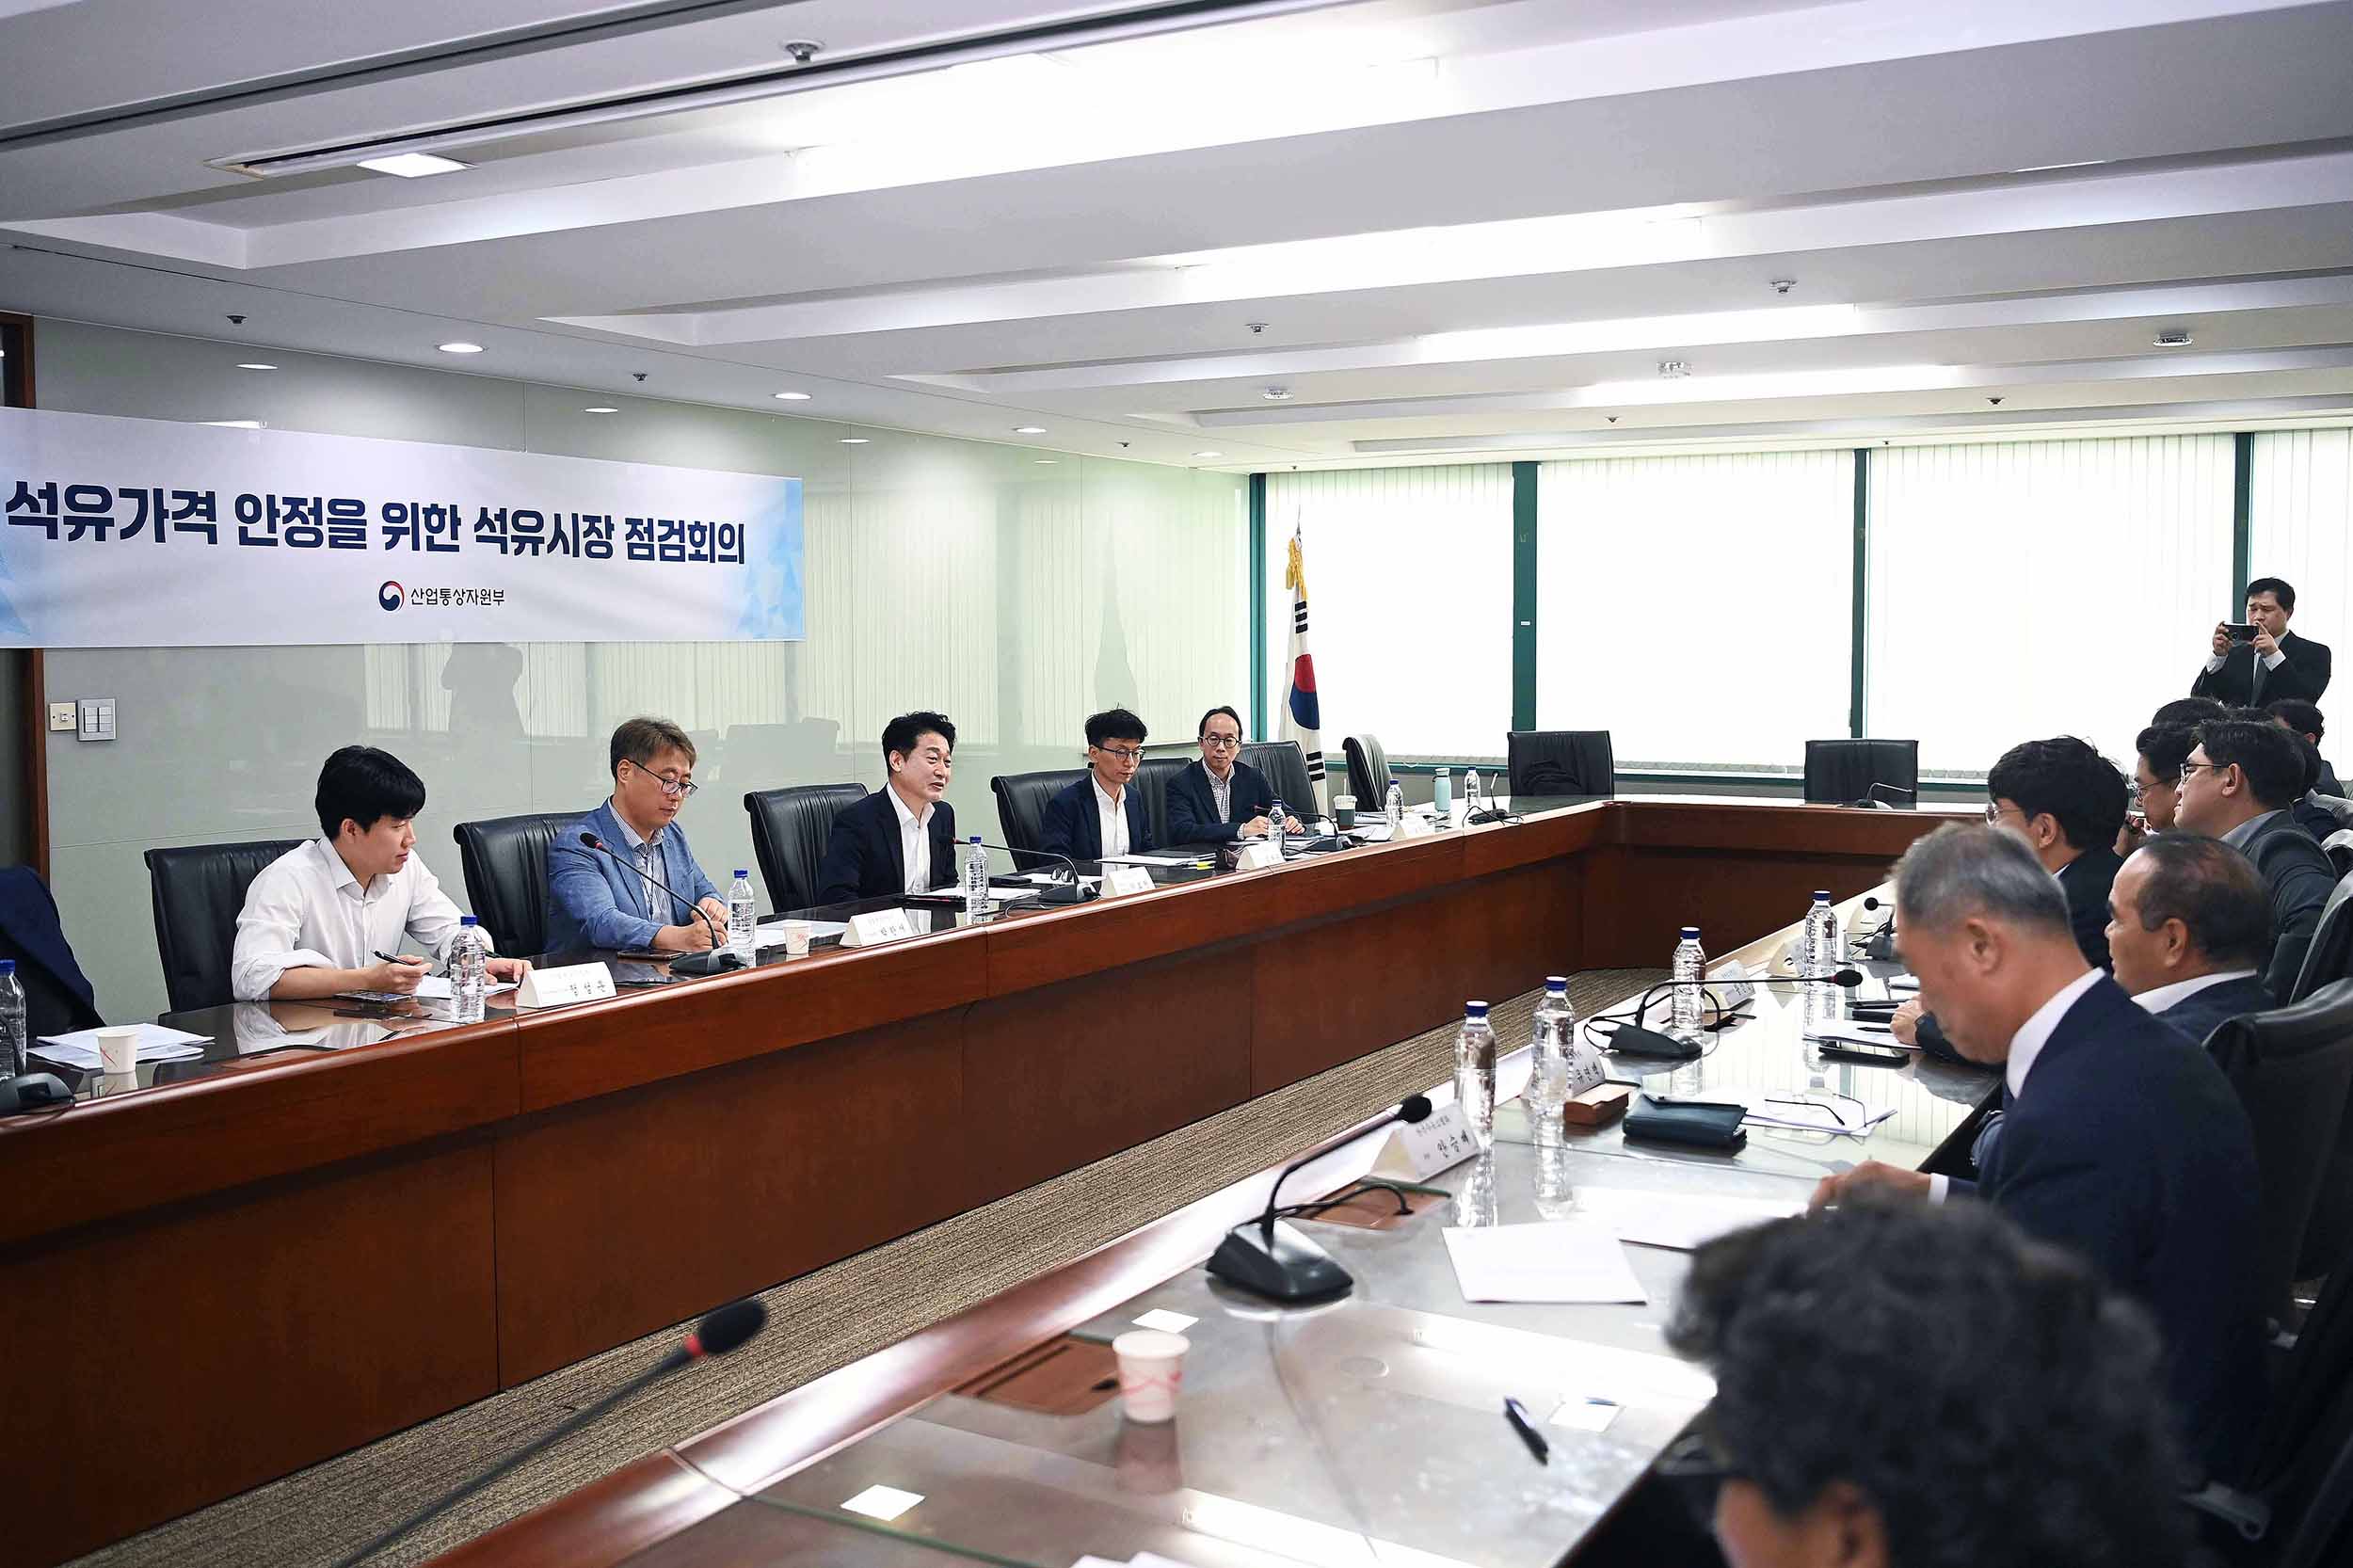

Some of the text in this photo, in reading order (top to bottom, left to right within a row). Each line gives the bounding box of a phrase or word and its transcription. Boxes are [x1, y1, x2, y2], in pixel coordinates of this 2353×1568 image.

[6, 480, 745, 565] 석유가격 안정을 위한 석유시장 점검회의
[410, 587, 505, 607] 산업통상자원부
